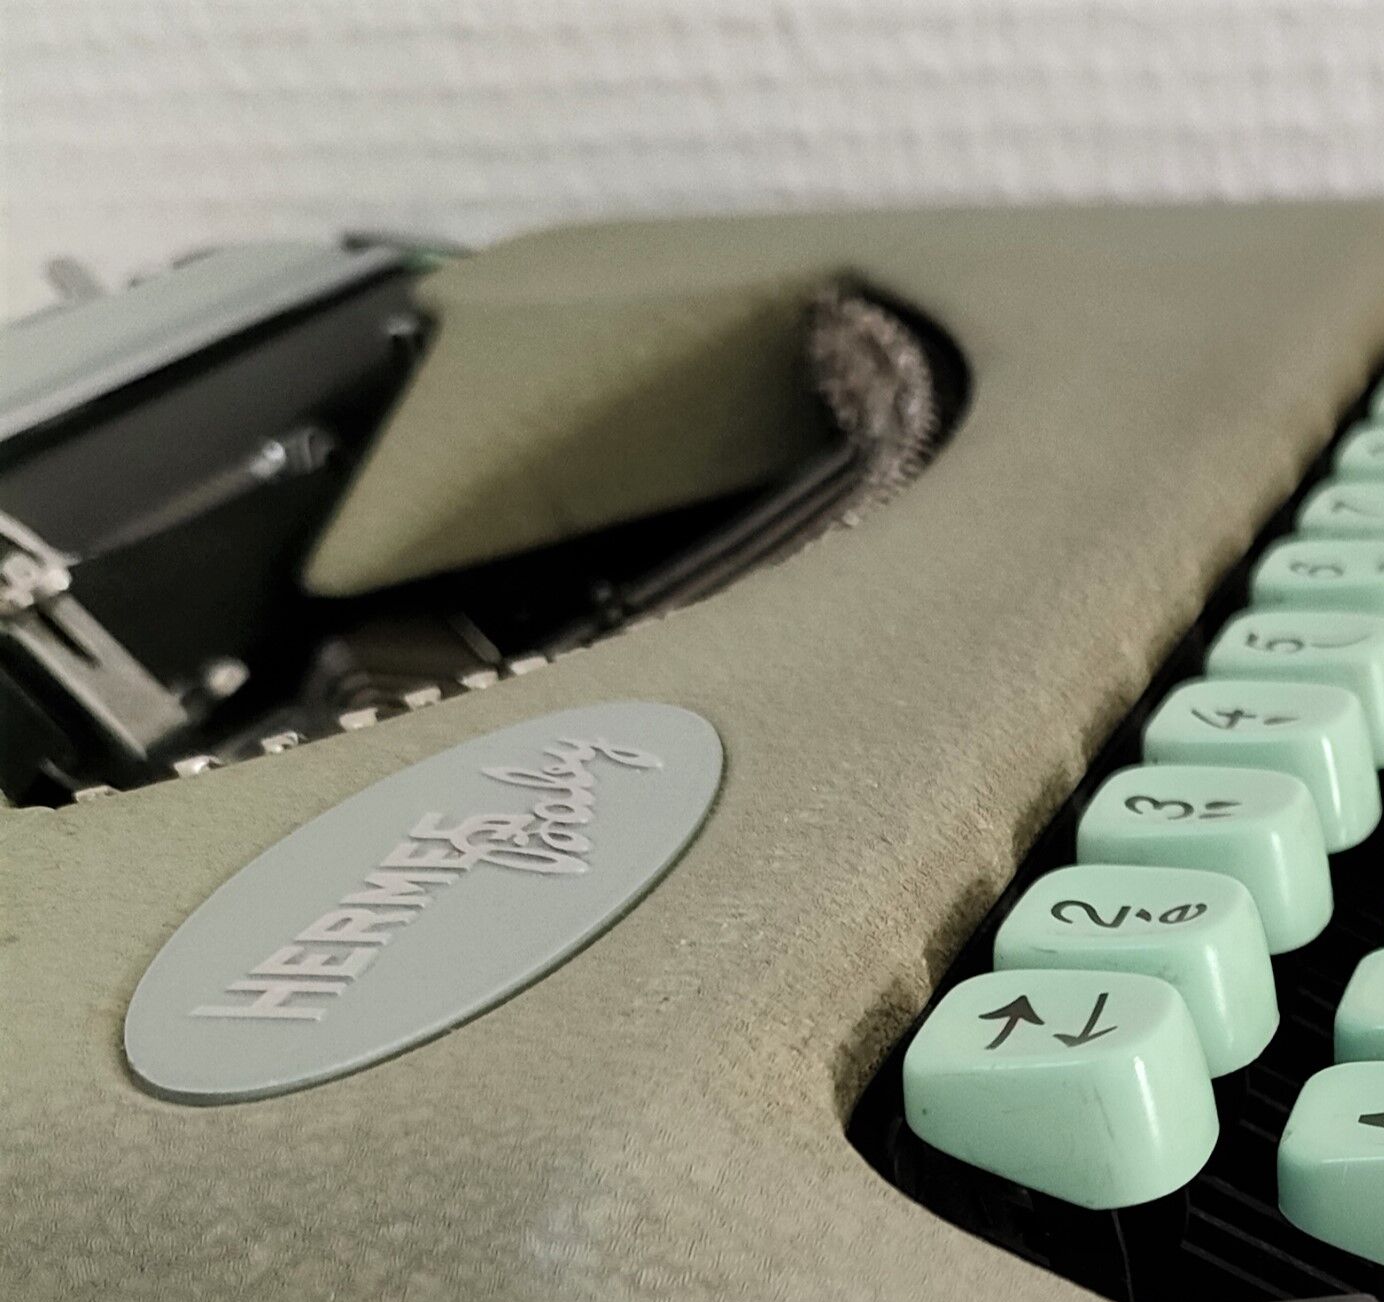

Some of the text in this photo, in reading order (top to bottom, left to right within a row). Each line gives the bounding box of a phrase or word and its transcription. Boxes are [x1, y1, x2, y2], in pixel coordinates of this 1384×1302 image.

[1245, 631, 1305, 652] 5
[1190, 708, 1257, 731] 4
[1124, 794, 1195, 821] 3
[1051, 899, 1131, 929] 2
